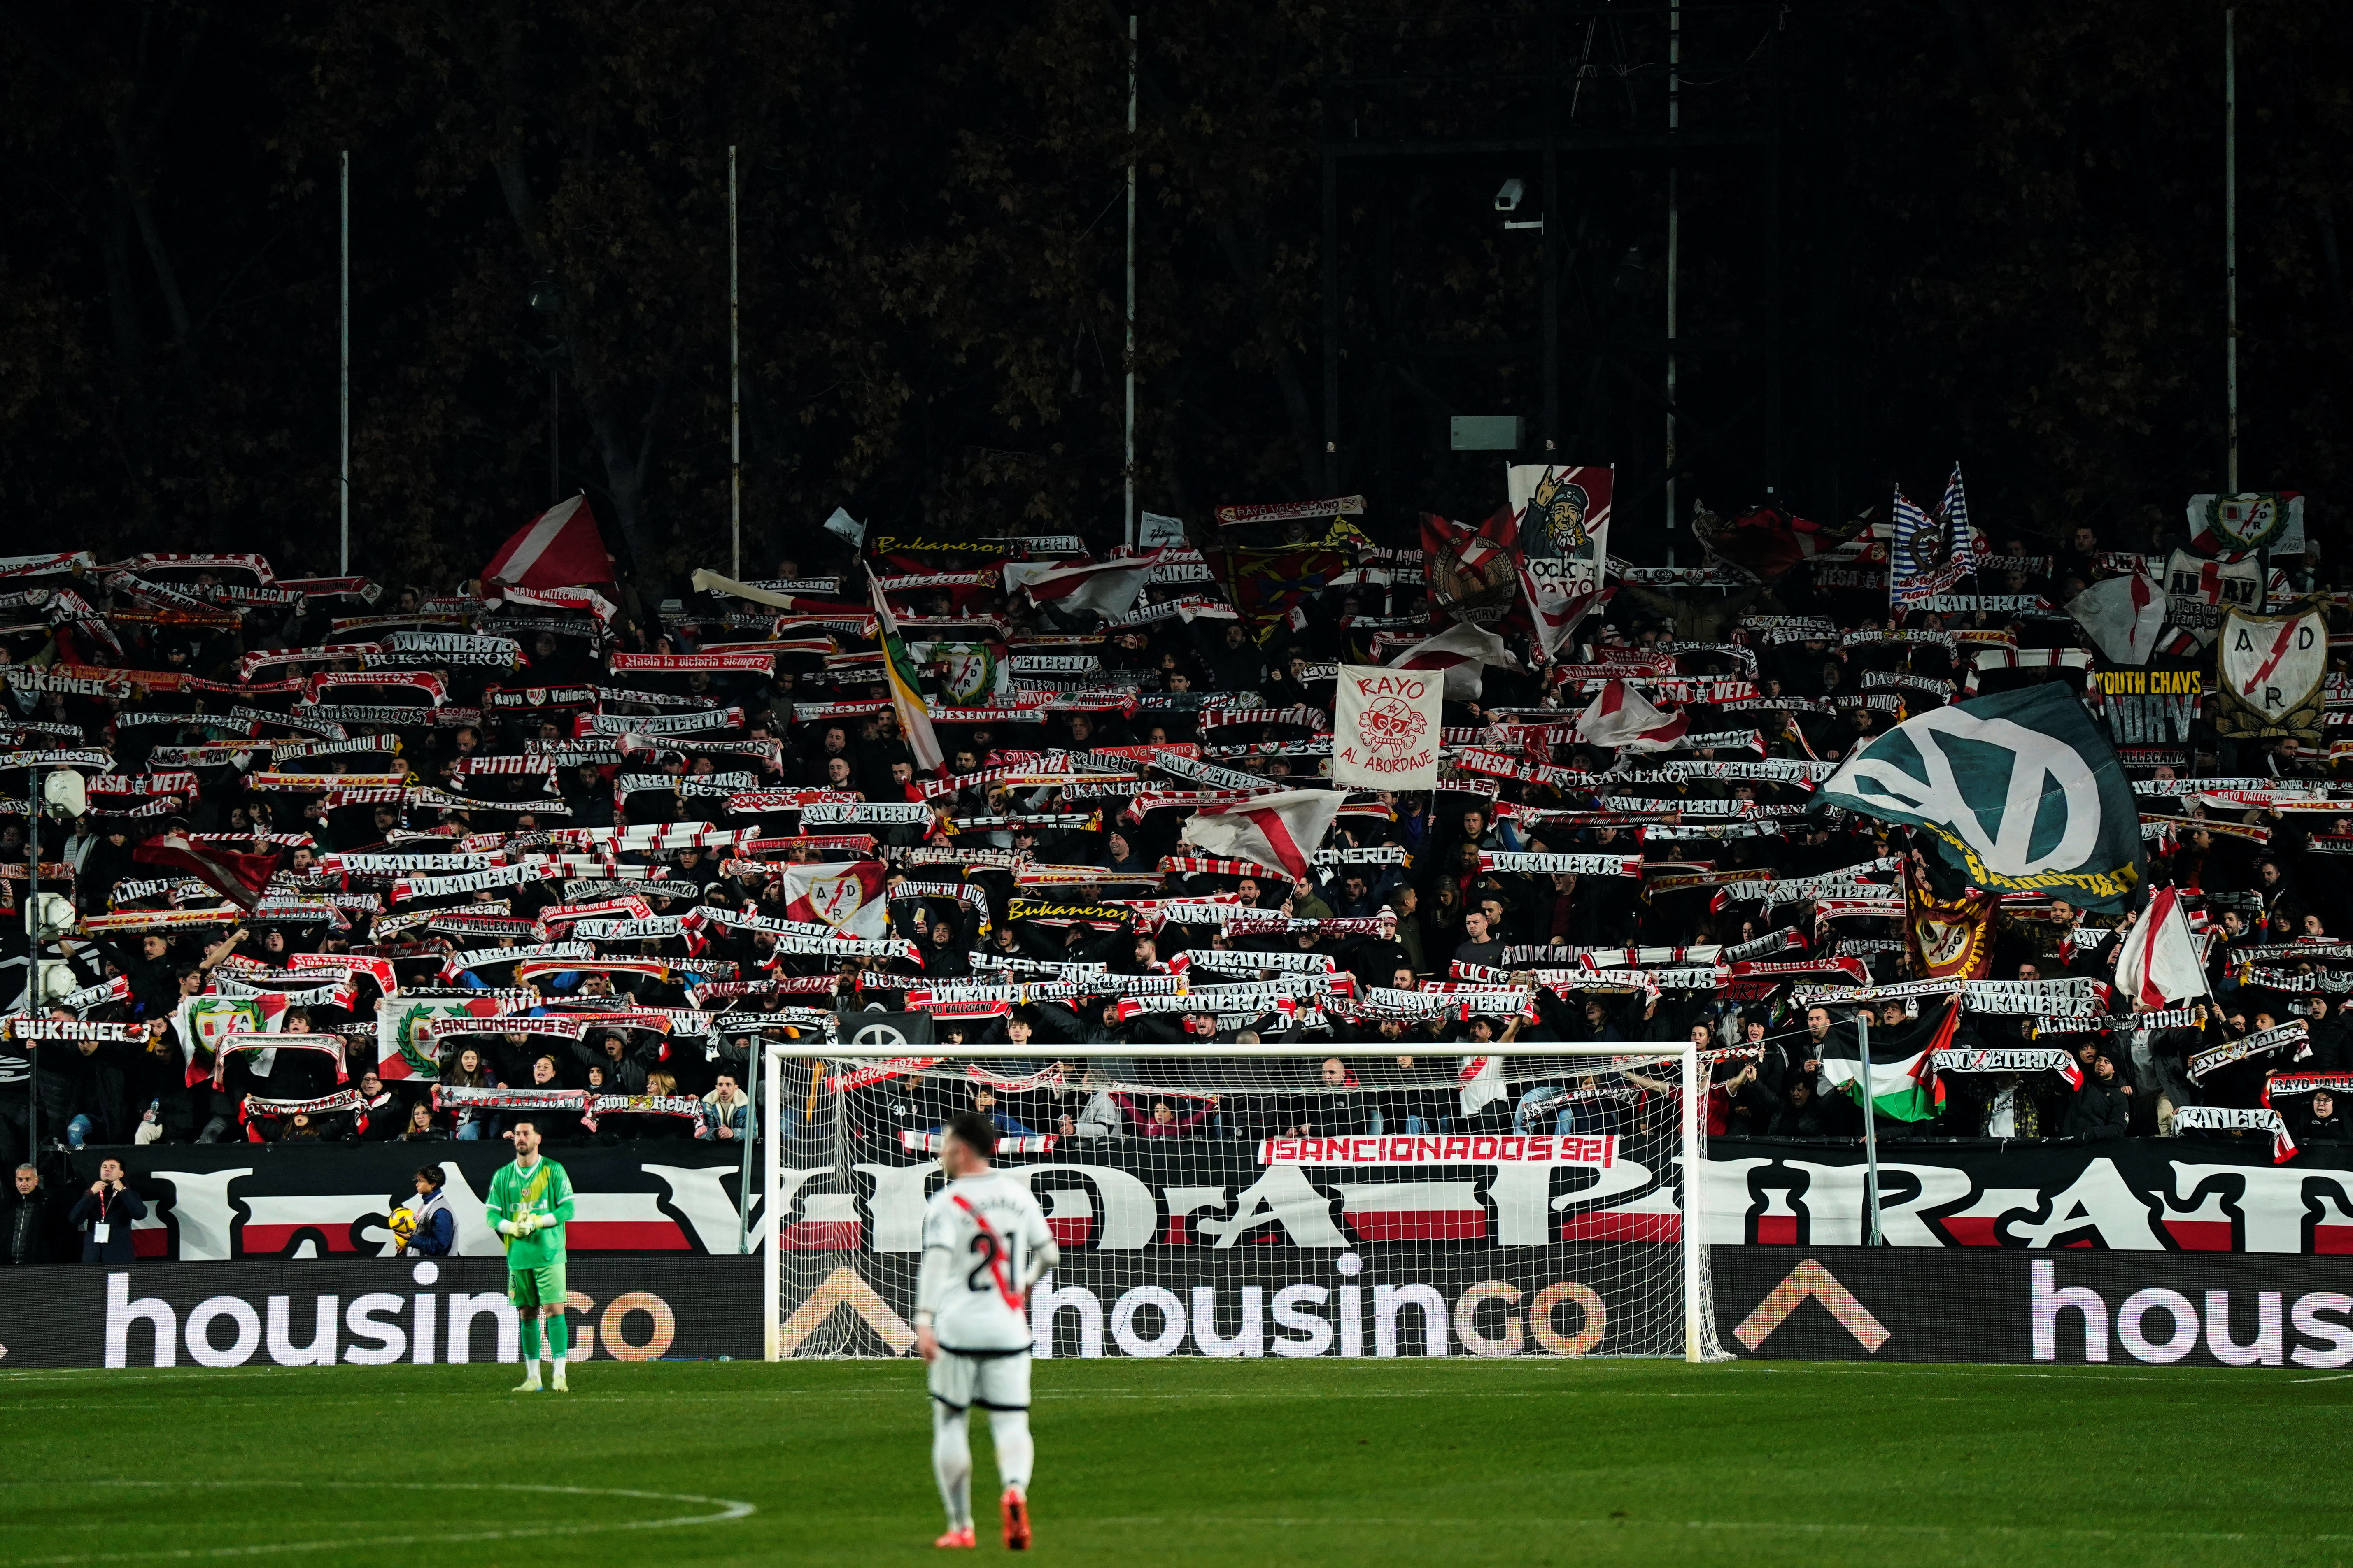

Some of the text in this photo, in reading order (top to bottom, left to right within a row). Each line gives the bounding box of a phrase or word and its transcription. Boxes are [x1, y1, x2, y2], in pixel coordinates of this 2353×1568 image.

[1237, 499, 1340, 517] RAYO VALLECANO
[877, 536, 1004, 554] Bukaneros
[130, 579, 143, 590] R.
[310, 580, 348, 592] VALLECANO
[539, 587, 587, 600] VALLECANO
[224, 585, 303, 603] VALLECANO
[394, 634, 515, 653] BUKANEROS
[2235, 626, 2314, 653] A D
[364, 653, 515, 668] BUKANEROS
[664, 656, 674, 667] la
[678, 656, 719, 667] victoria
[974, 658, 982, 668] A
[1018, 656, 1093, 673] ETERNO
[1357, 676, 1425, 699] RAYO
[1714, 681, 1753, 700] VETE
[2096, 670, 2202, 694] YOUTH CHAVS
[495, 693, 522, 705] Rayo
[1018, 693, 1123, 705] RAYO ATHLETIC
[1141, 696, 1236, 709] 1924 2024
[2266, 686, 2285, 712] R
[297, 705, 433, 726] Bukaneros
[596, 712, 723, 734] RAYO ETERNO
[657, 737, 767, 755] BUKANEROS
[471, 757, 523, 775] PUTO
[1161, 754, 1195, 775] RAYO
[1340, 747, 1434, 773] AL ABORDAJE
[1460, 749, 1514, 776] PRESA
[1730, 763, 1801, 779] ETERNO
[929, 781, 951, 798] EL
[2185, 779, 2261, 793] ETERNO
[342, 789, 401, 806] PUTO
[1606, 797, 1646, 812] RAYO
[2242, 790, 2291, 802] VALLECANO
[803, 805, 929, 822] RAYO ETERNO
[554, 829, 573, 843] EL
[340, 853, 492, 871] BUKANEROS
[1491, 853, 1624, 876] BUKANEROS
[409, 862, 542, 898] BUKANEROS
[816, 885, 855, 899] A D
[833, 908, 843, 920] R
[1008, 899, 1129, 921] Bukaneros
[1822, 909, 1846, 917] BELLA
[435, 917, 531, 933] RAYO VALLECANO
[776, 936, 909, 957] BUKANEROS
[1192, 949, 1327, 973] BUKANEROS
[1964, 979, 2094, 998] BUKANEROS
[944, 1003, 992, 1014] VALLECANO
[1142, 994, 1279, 1013] BUKANEROS
[1321, 994, 1442, 1021] BUKANEROS
[1402, 994, 1440, 1010] RAYO
[1964, 993, 2095, 1017] BUKANEROS
[240, 1015, 249, 1024] A
[435, 1017, 554, 1036] SANCIONADOS
[756, 1012, 824, 1025] PIRATA
[1934, 1050, 2064, 1069] RAYO ETERNO
[2274, 1078, 2310, 1091] RAYO
[461, 1095, 585, 1110] RAYO VALLECANO
[893, 1105, 906, 1116] 30
[1276, 1137, 1602, 1162] SANCIONADOS 92
[968, 1231, 1017, 1293] 21
[1030, 1252, 1607, 1358] housinGO
[105, 1261, 675, 1368] housinGO
